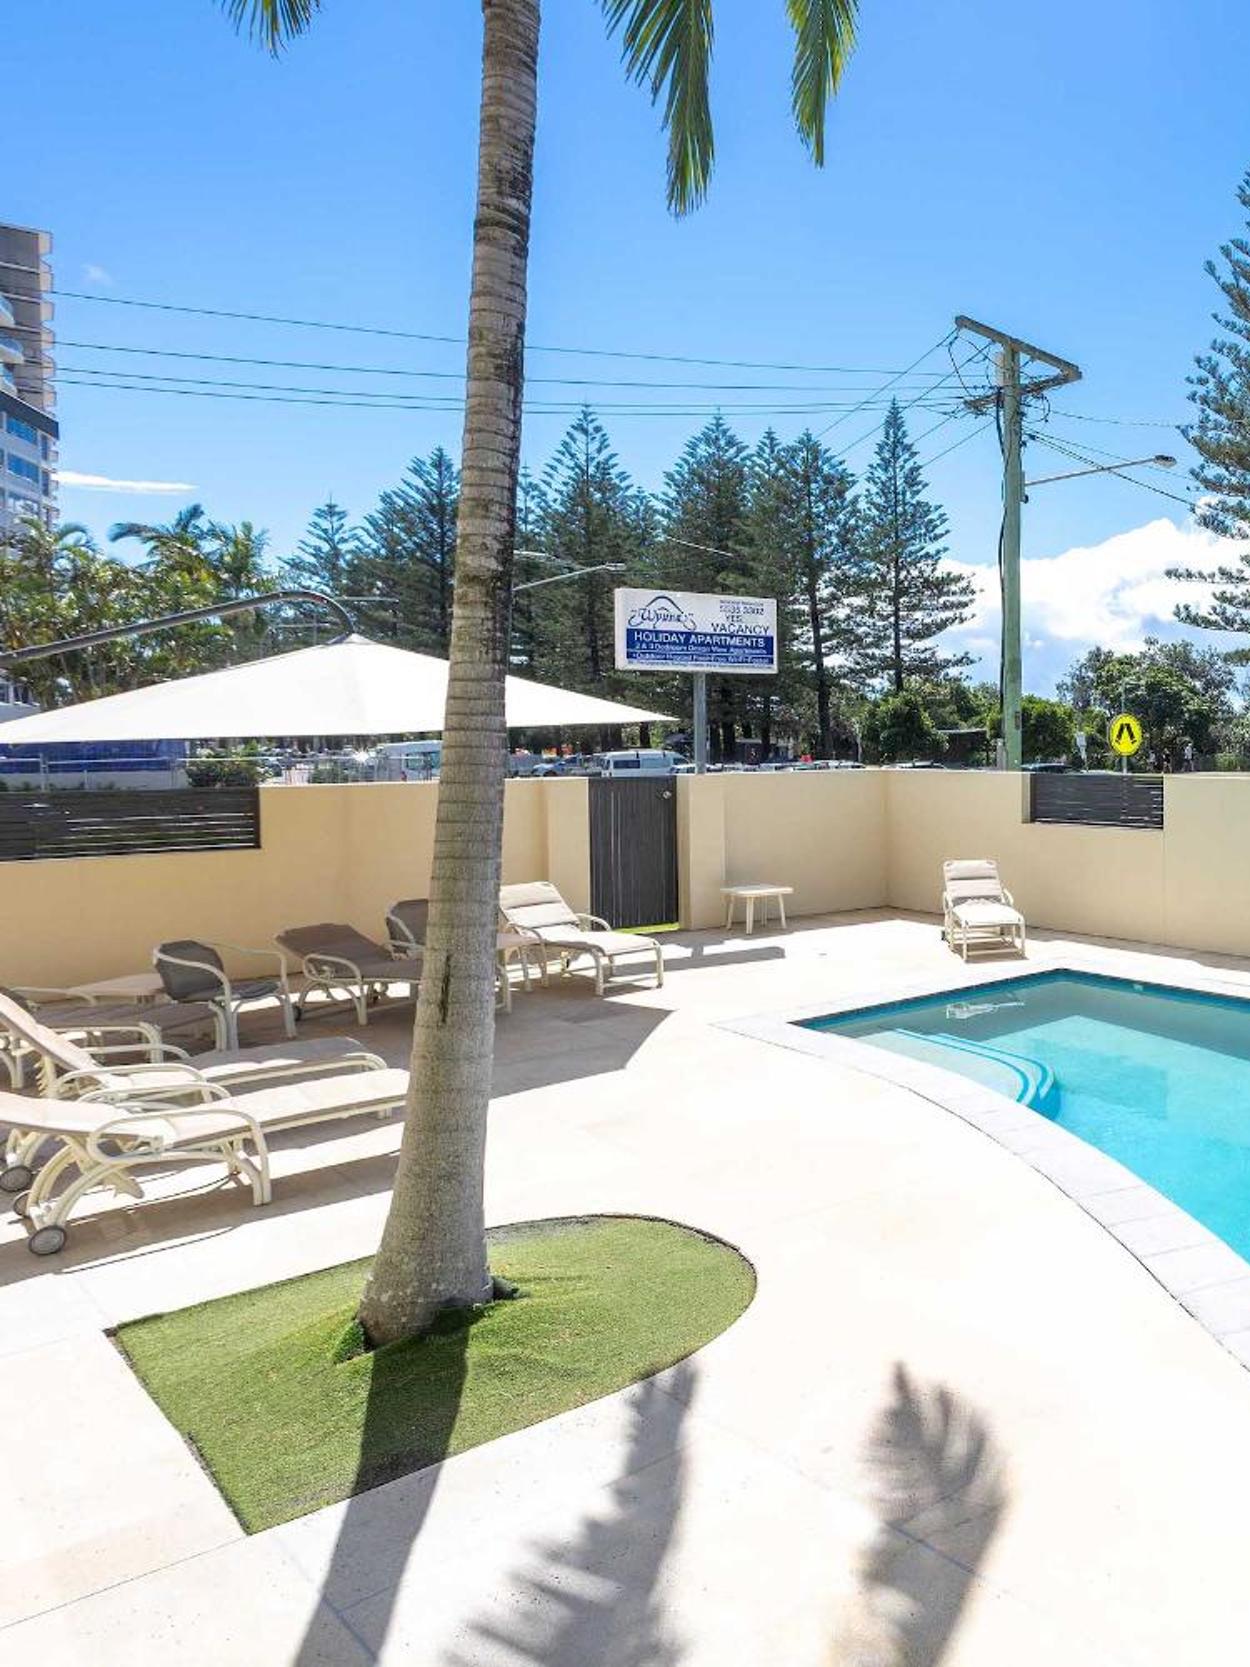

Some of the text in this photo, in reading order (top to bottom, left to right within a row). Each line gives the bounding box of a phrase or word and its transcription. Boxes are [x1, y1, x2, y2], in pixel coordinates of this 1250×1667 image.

[711, 623, 770, 635] VACANCY
[634, 631, 766, 647] HOLIDAY APARTMENTS
